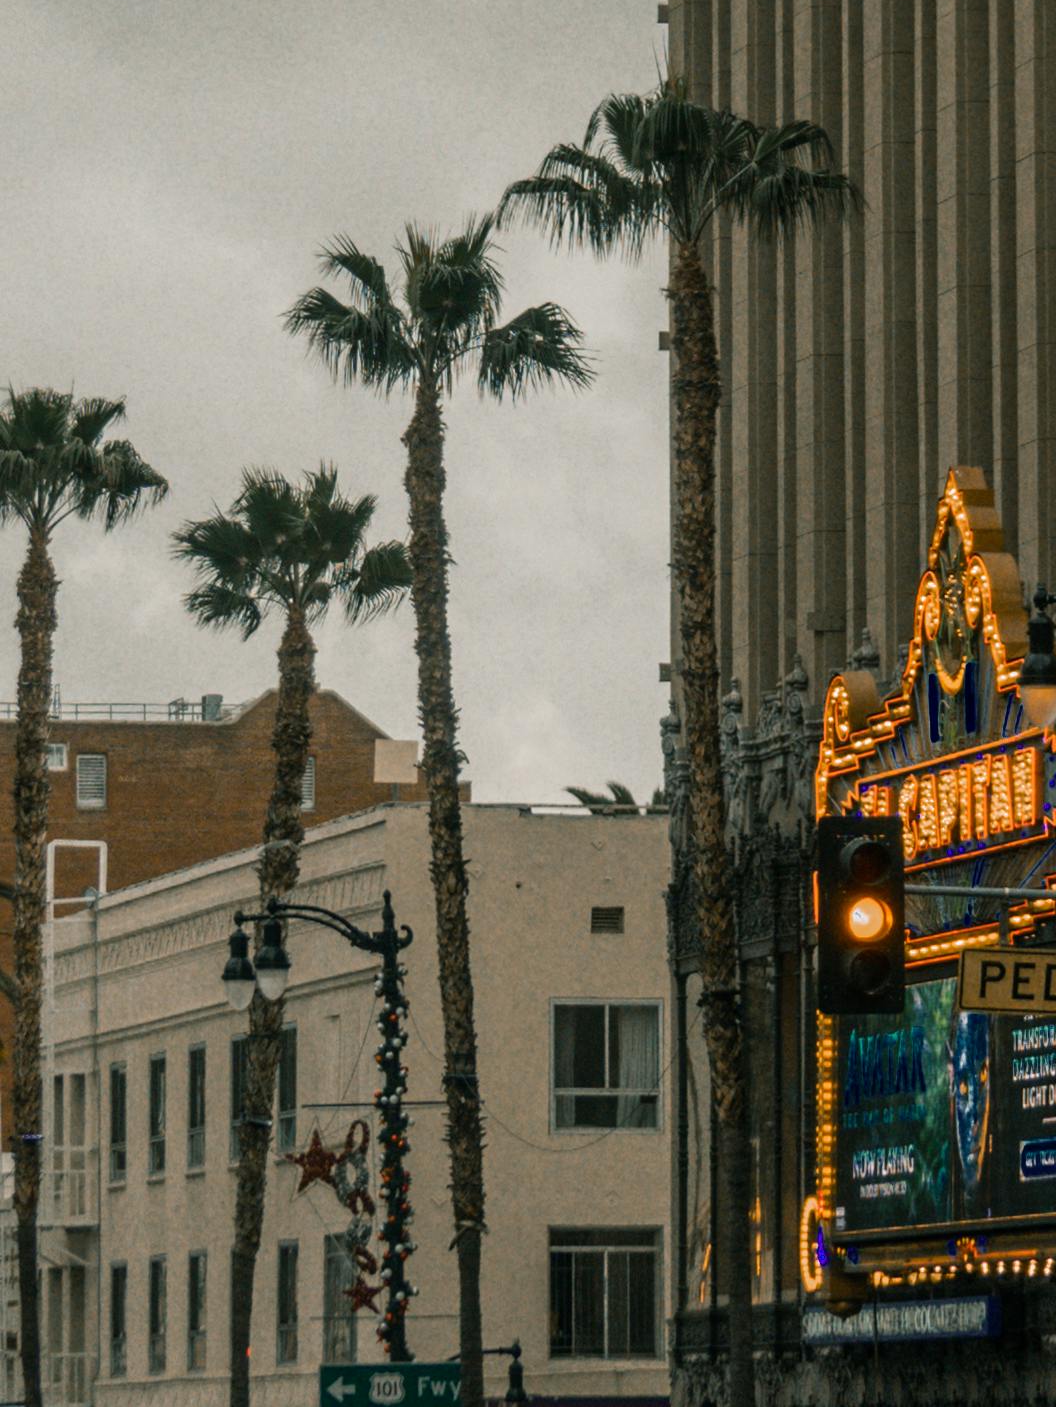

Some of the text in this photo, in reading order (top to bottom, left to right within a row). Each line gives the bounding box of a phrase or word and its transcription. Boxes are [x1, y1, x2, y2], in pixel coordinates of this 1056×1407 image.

[899, 746, 1037, 861] CAPITAN
[1011, 1054, 1056, 1082] DAZZLING
[1022, 1085, 1047, 1110] LIGHT
[852, 1143, 915, 1179] NOW PLAYING
[376, 1376, 462, 1401] 101 Fwy
